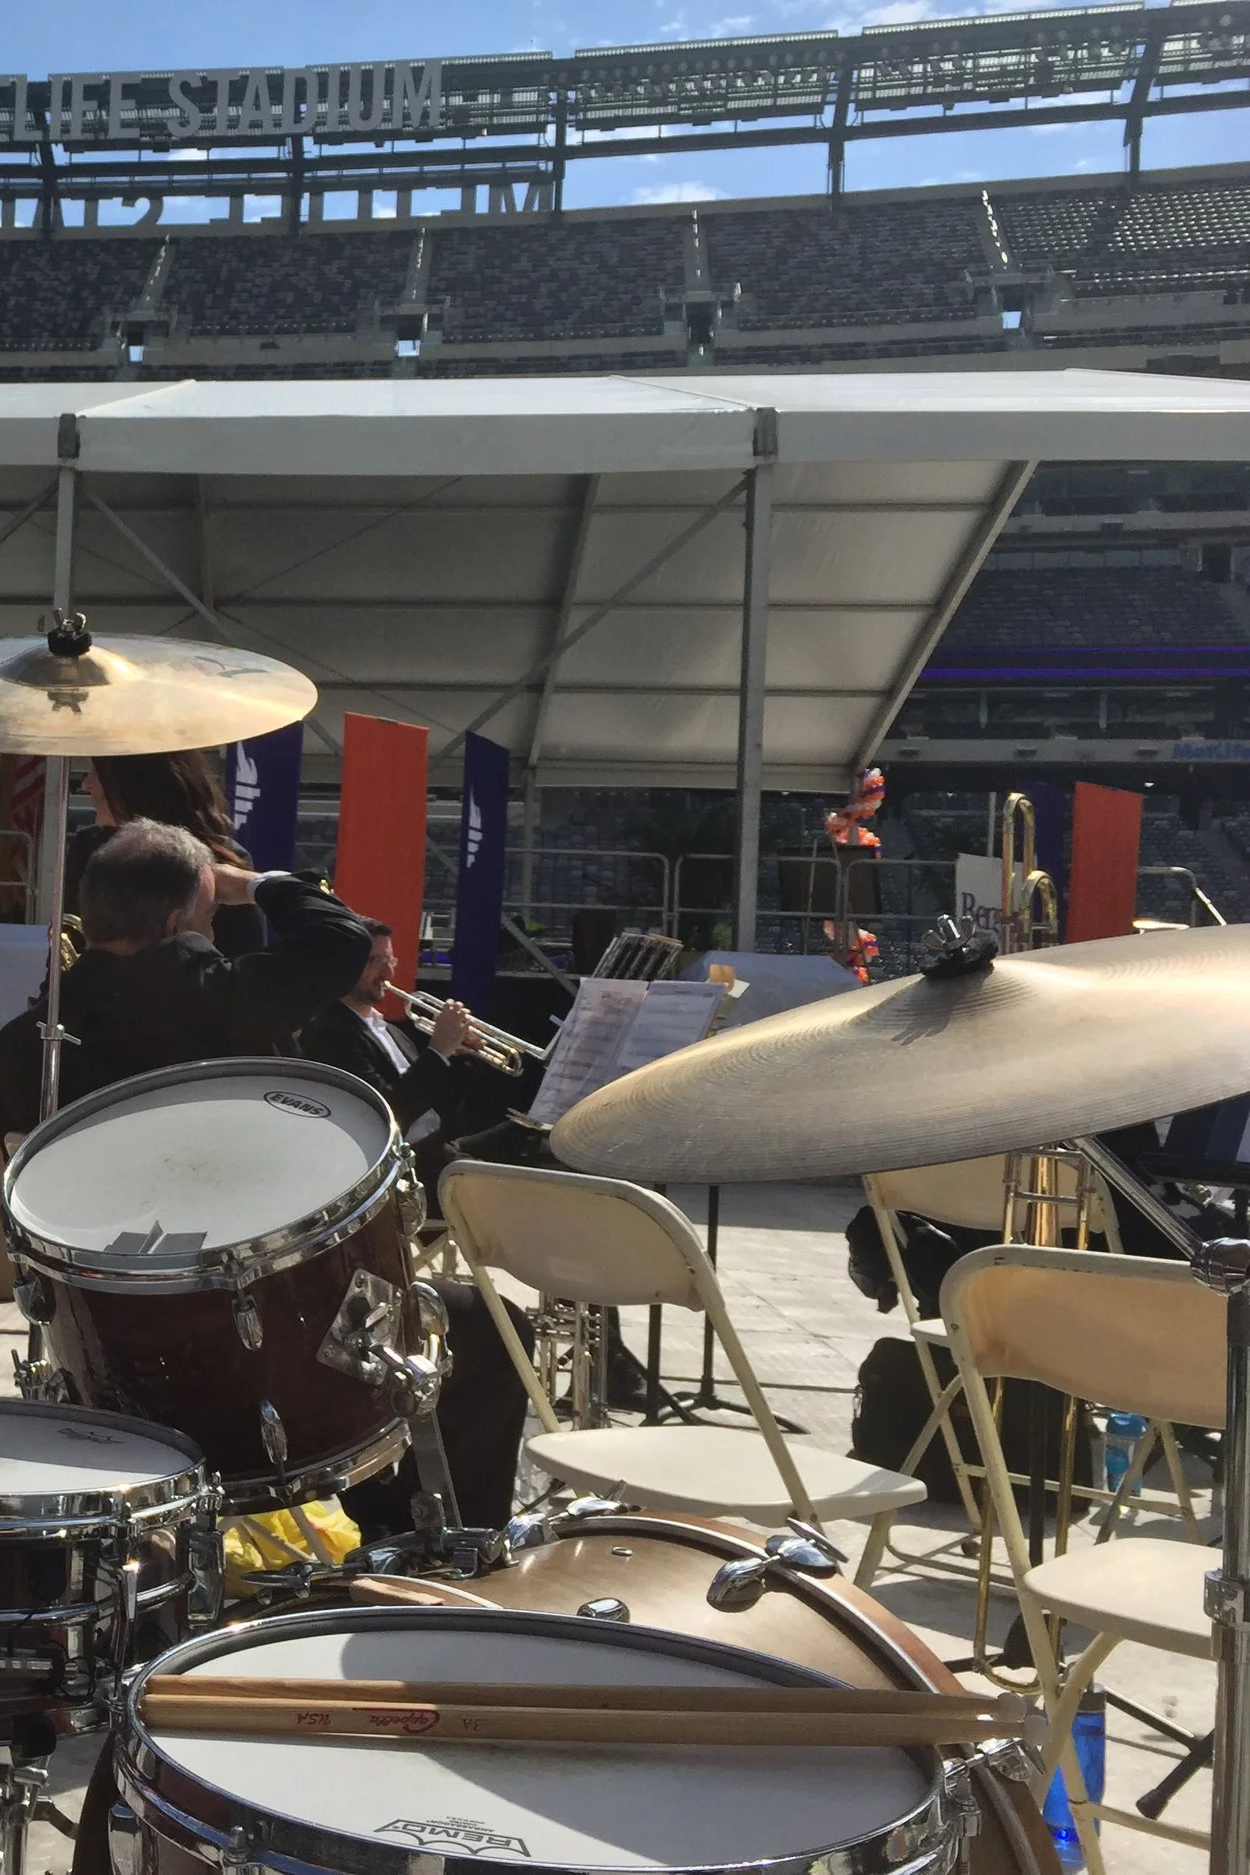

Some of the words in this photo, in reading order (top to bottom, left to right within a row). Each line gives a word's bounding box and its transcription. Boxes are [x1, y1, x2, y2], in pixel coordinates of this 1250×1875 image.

[167, 60, 443, 138] STADIUM
[270, 1093, 324, 1114] EVANS
[297, 1713, 331, 1726] USA
[367, 1707, 441, 1733] Cappella
[401, 1823, 511, 1847] REMO
